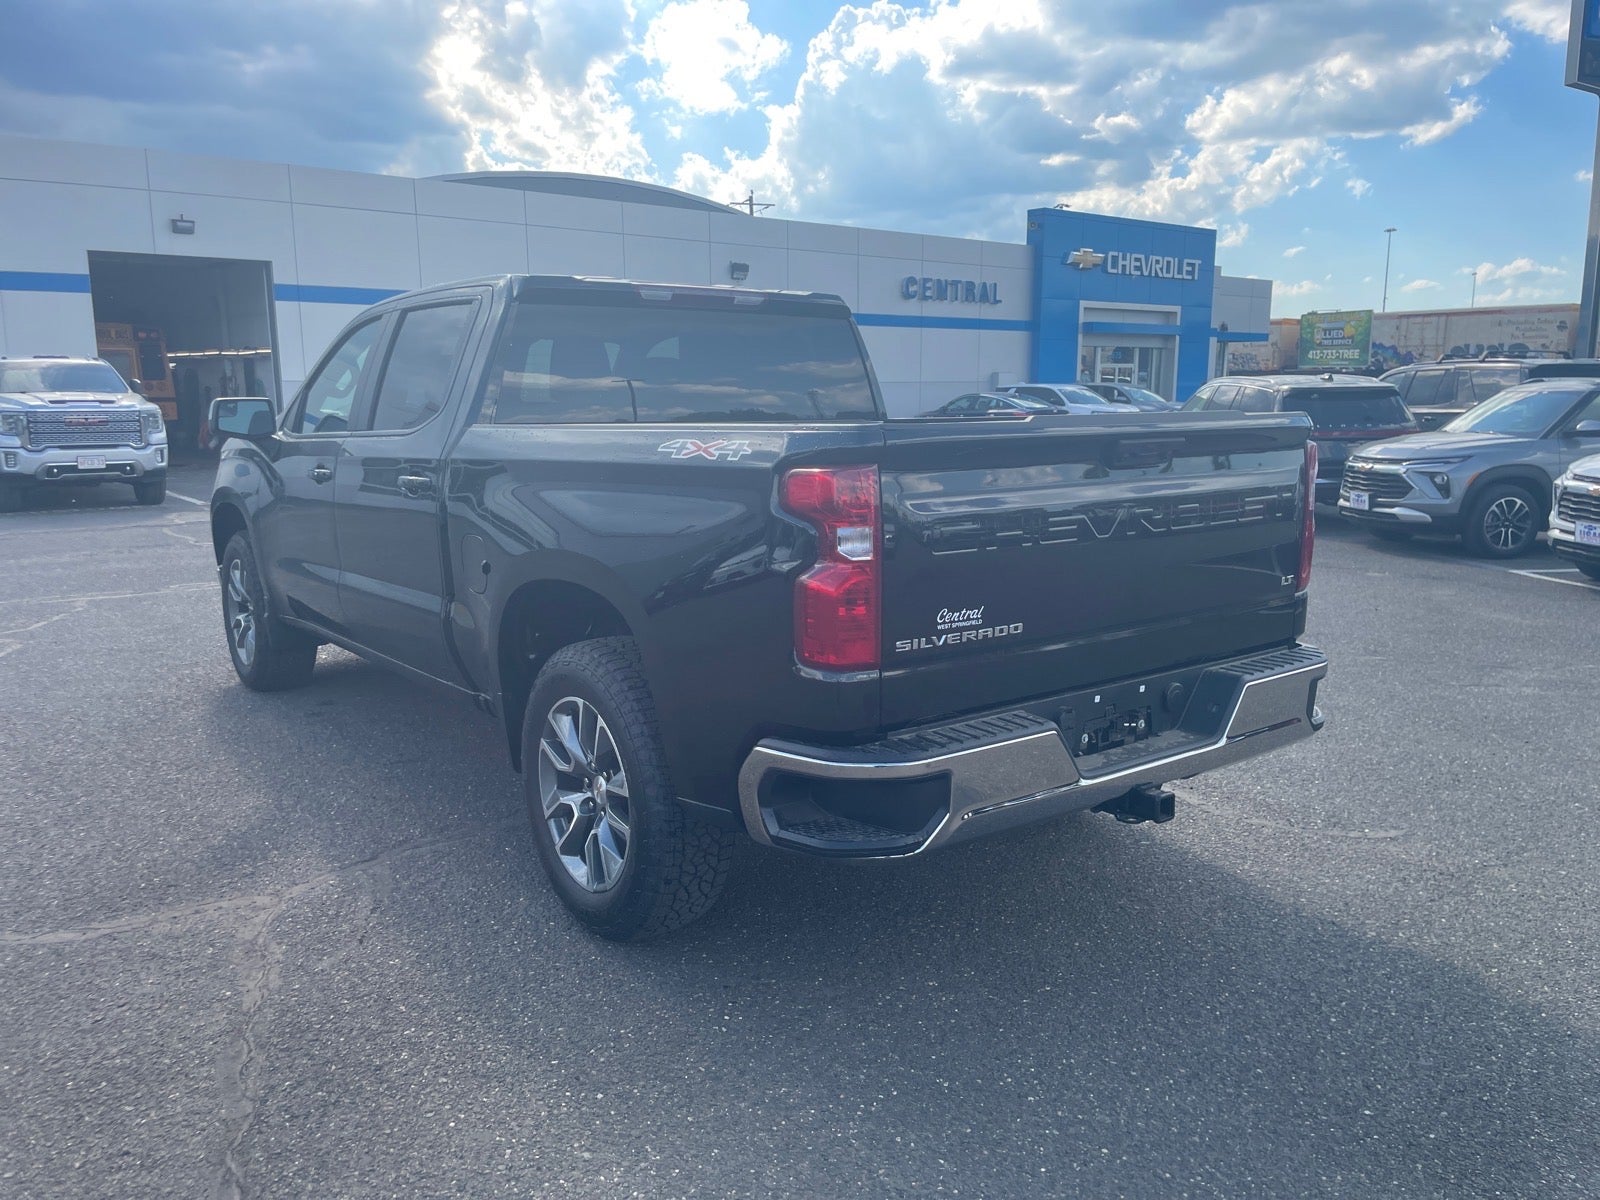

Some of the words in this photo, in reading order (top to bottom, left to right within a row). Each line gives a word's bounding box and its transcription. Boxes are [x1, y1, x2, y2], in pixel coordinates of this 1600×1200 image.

[1106, 250, 1201, 281] CHEVROLET
[901, 275, 1003, 305] CENTRAL
[1281, 574, 1295, 586] LT
[936, 605, 985, 623] Central
[951, 618, 983, 629] SPRINGFIELD
[895, 622, 1024, 652] SILVERADO
